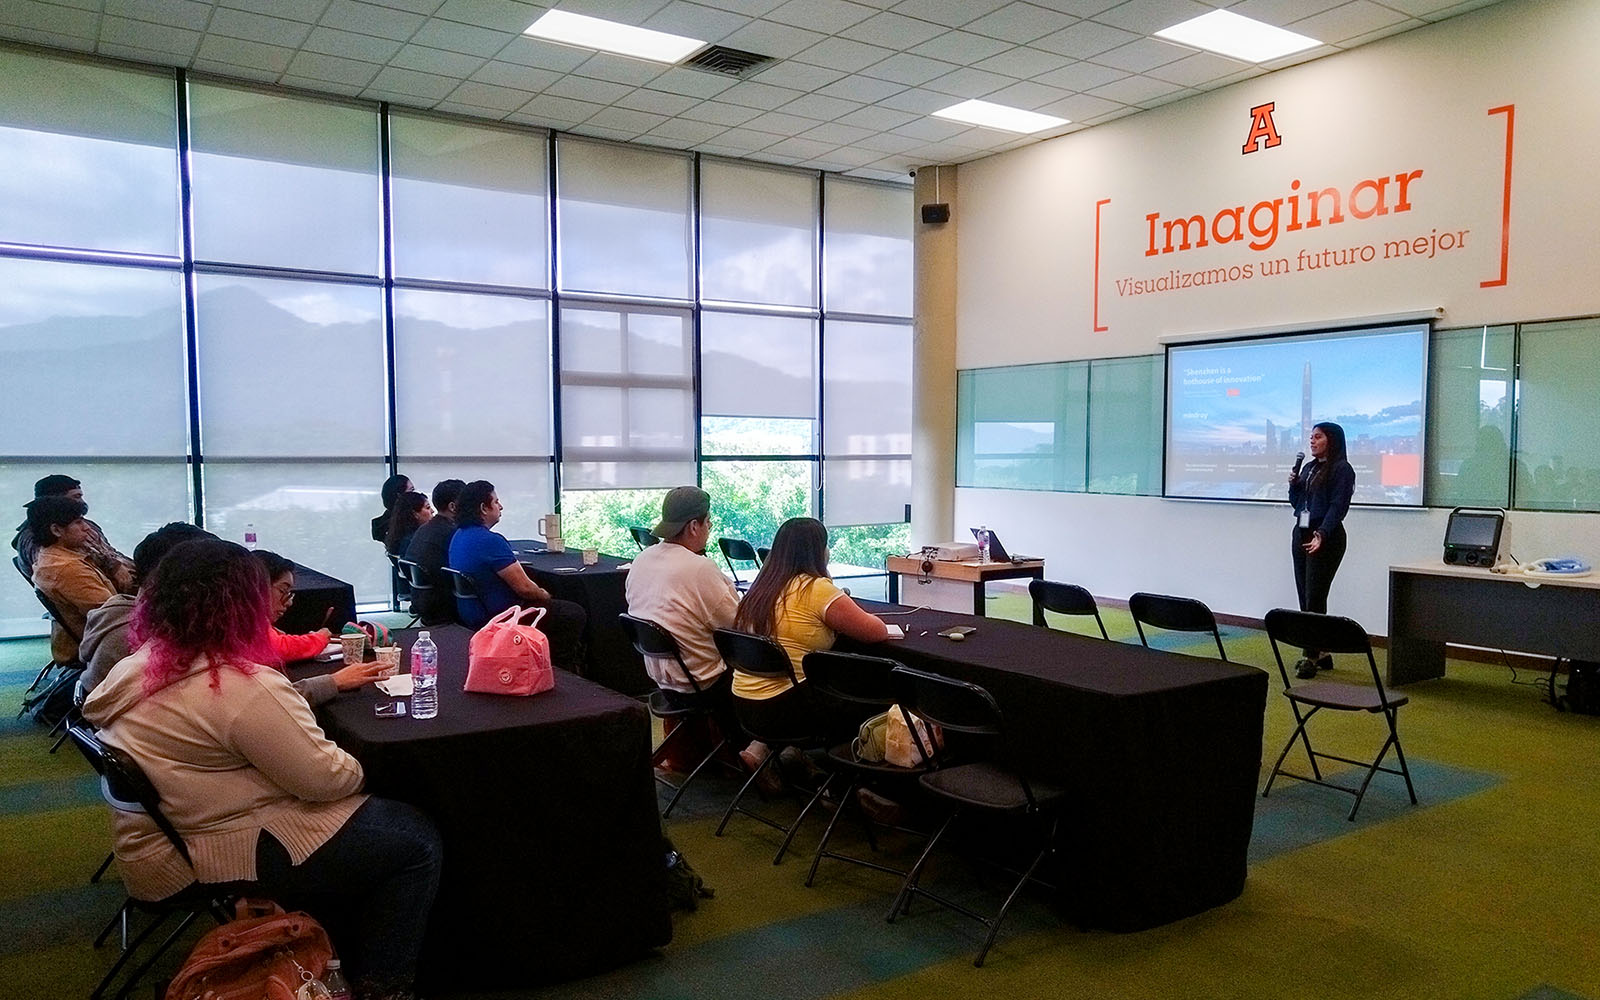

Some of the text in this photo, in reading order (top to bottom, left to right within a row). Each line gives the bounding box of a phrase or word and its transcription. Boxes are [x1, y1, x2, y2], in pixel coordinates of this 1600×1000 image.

[1242, 101, 1282, 155] A
[1145, 169, 1424, 257] Imaginar
[1115, 228, 1471, 297] Visualizamos un futuro mejor
[1215, 376, 1223, 384] of
[1219, 366, 1226, 375] is
